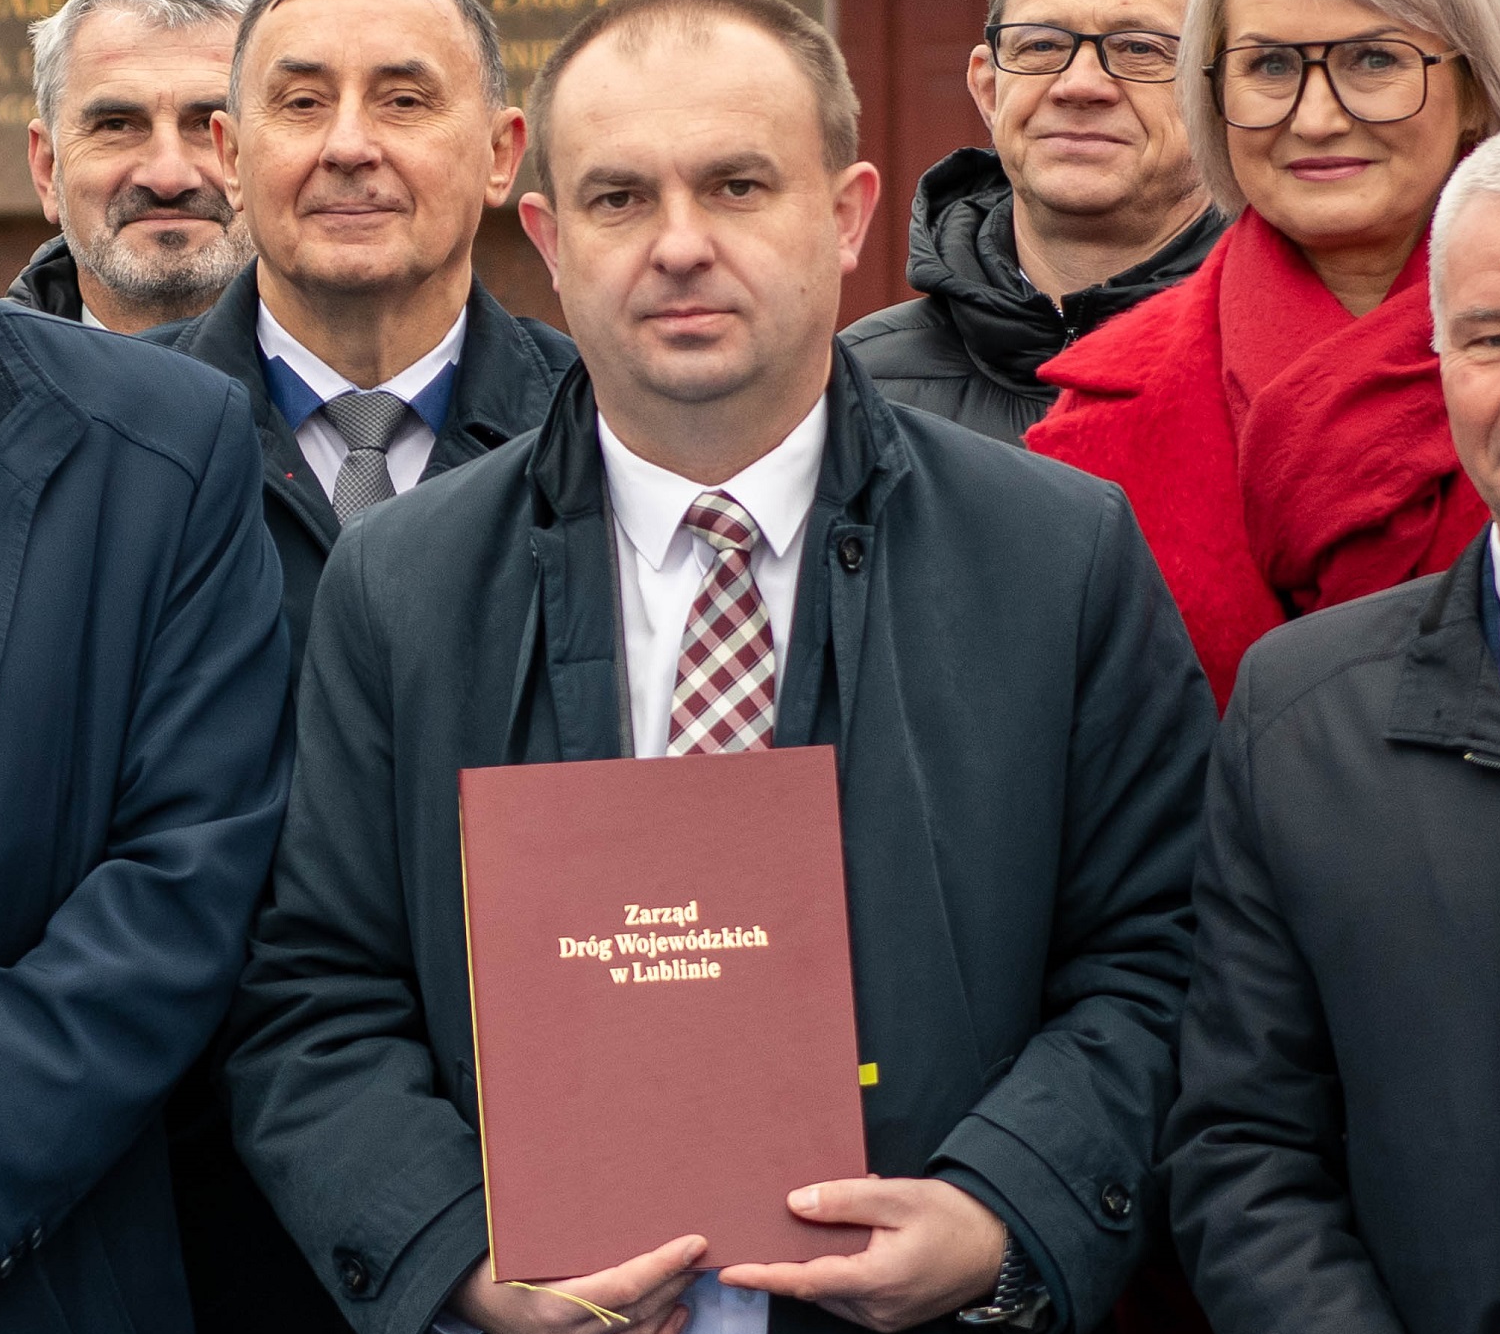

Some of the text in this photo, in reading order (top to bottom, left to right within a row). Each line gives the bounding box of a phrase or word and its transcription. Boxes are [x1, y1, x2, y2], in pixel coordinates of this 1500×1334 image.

[623, 900, 698, 928] Zarząd
[558, 925, 768, 961] Dróg Wojewódzkich
[610, 958, 721, 983] w Lublinie
